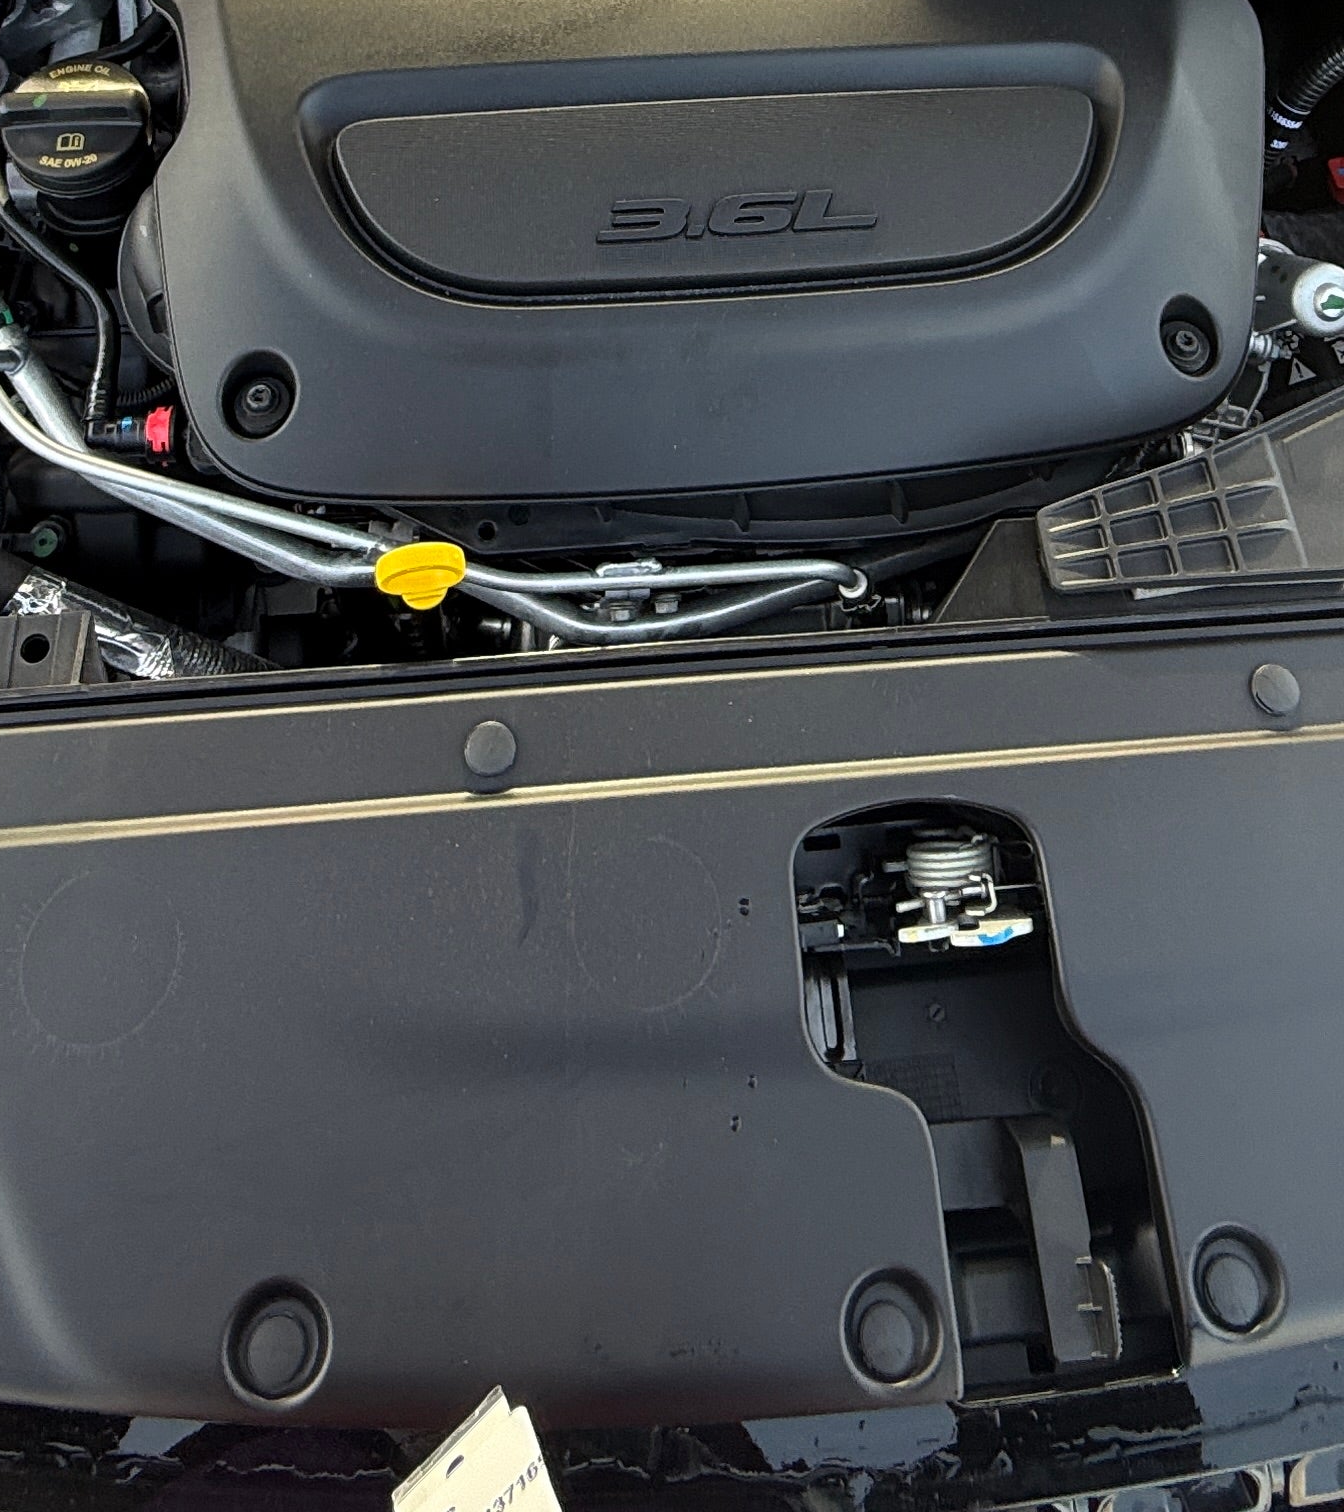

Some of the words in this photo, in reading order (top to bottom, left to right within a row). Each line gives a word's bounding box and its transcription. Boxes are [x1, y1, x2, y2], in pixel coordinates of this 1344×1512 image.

[49, 63, 93, 79] ENGINE
[94, 65, 111, 76] OIL
[39, 155, 63, 168] SAE
[64, 153, 98, 168] 0W-20
[595, 188, 878, 245] 3.6L
